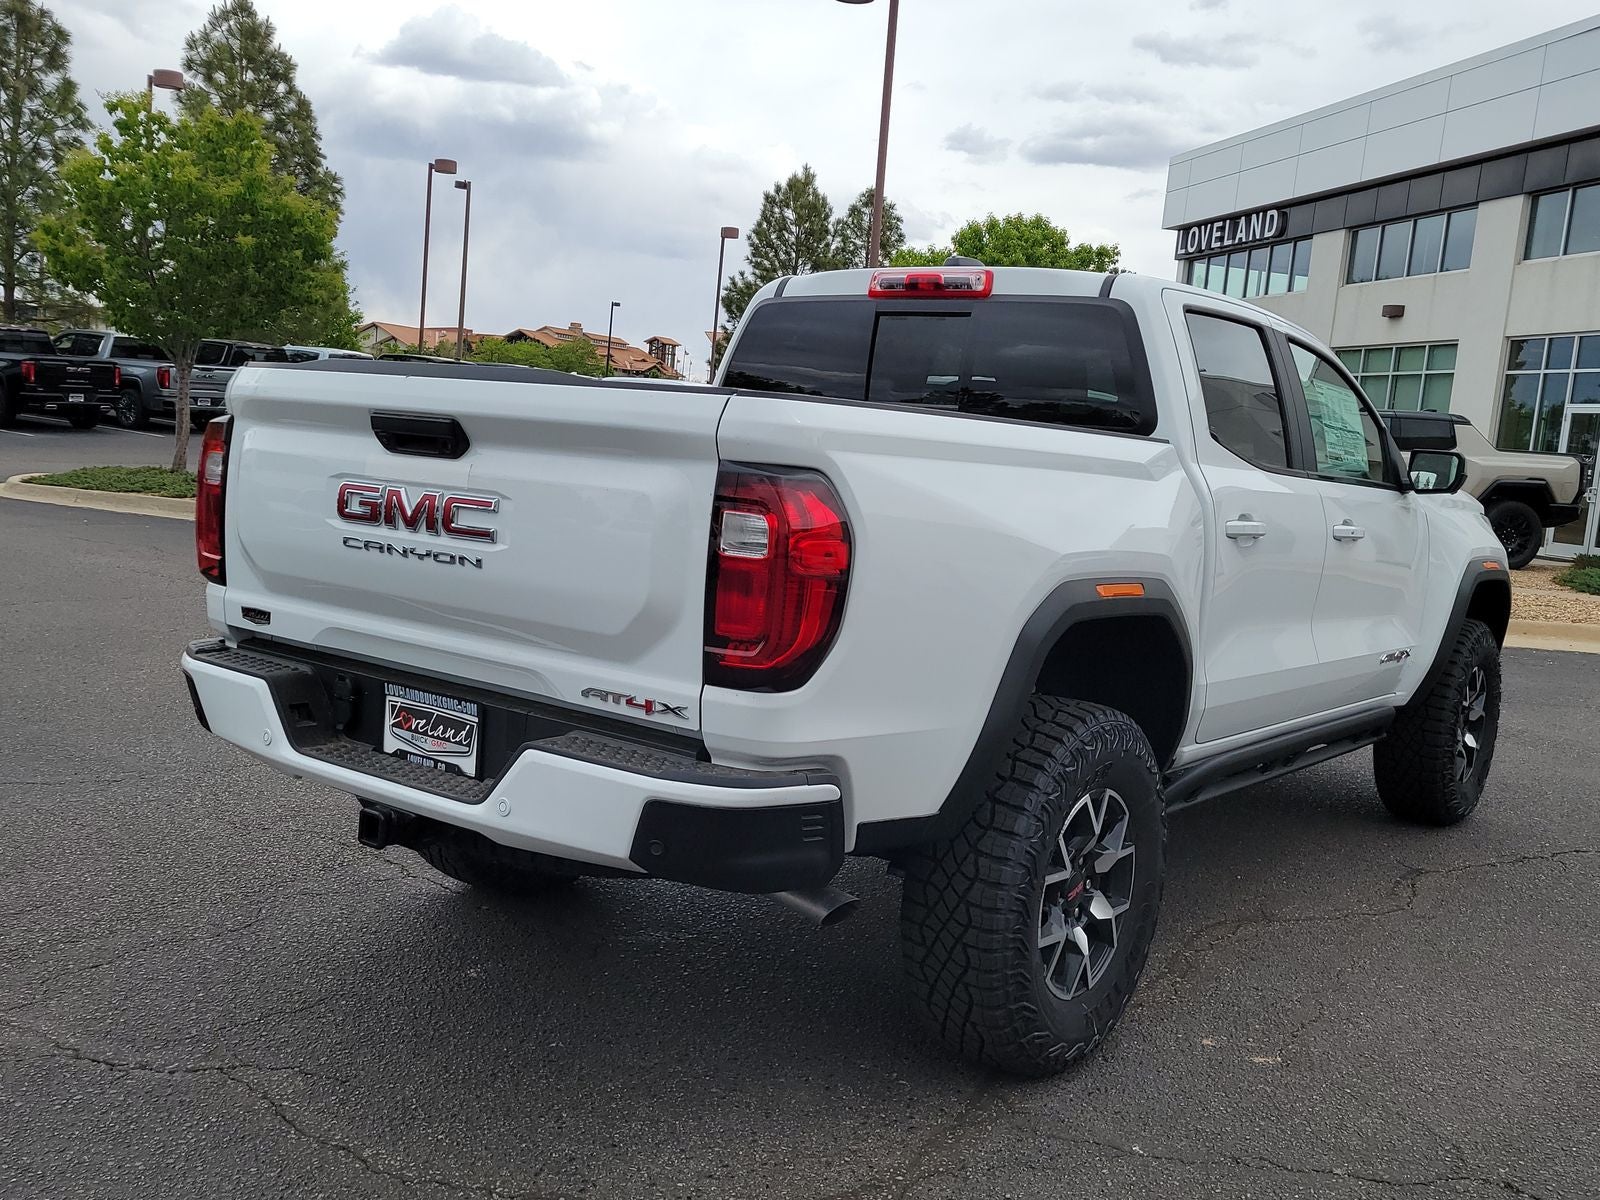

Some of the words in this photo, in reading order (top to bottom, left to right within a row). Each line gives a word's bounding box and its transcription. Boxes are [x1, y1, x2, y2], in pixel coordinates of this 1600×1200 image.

[1177, 209, 1279, 254] LOVELAND
[336, 481, 500, 544] GMC
[342, 536, 483, 569] CANYON
[580, 687, 689, 719] AT4X
[410, 733, 428, 744] BUICK
[431, 739, 448, 750] GMC
